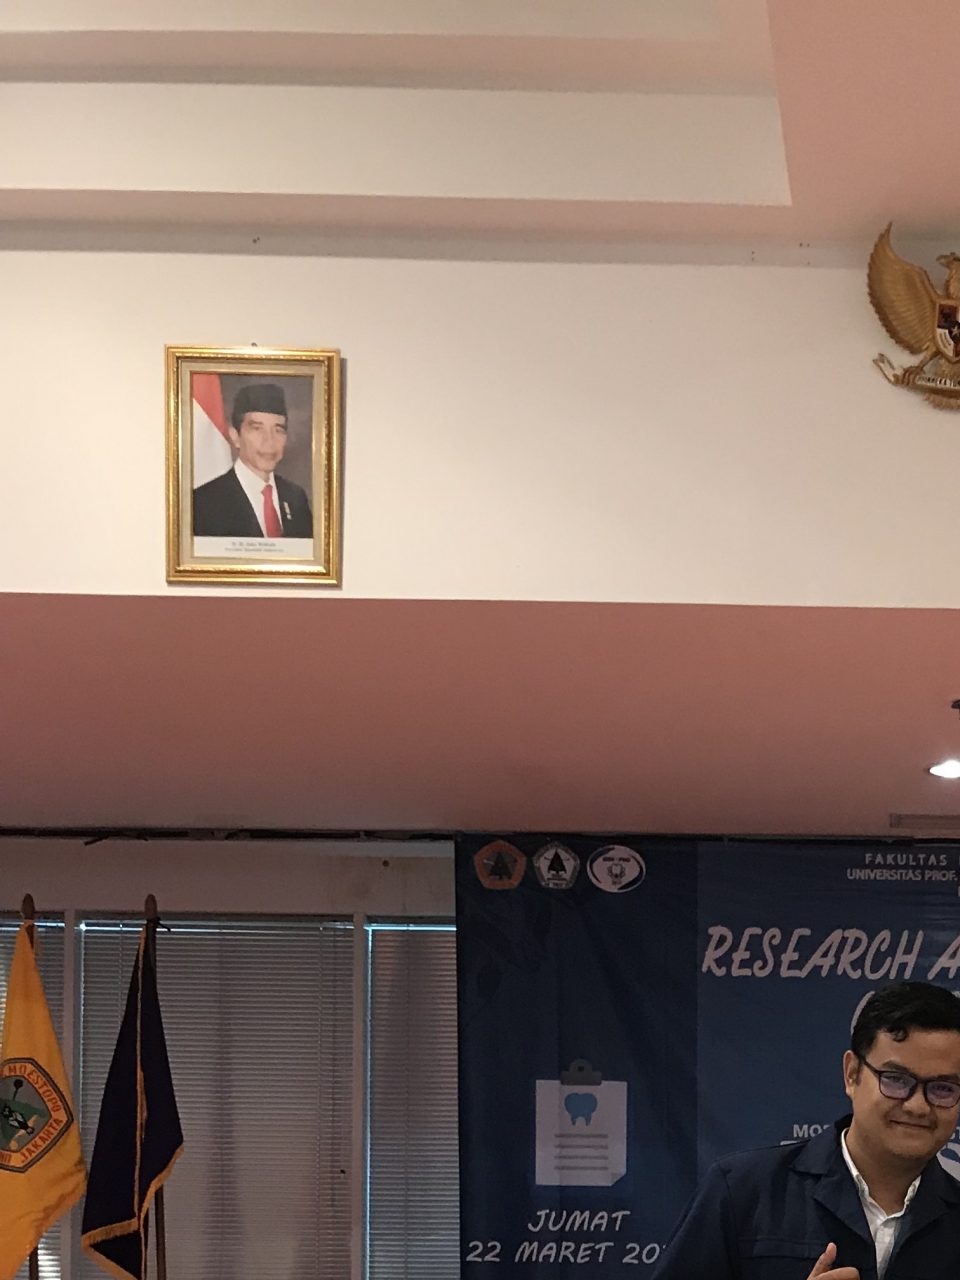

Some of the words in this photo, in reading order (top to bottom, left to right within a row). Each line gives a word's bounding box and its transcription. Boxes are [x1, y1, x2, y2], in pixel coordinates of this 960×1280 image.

[865, 853, 947, 866] FAKULTAS
[847, 868, 921, 880] UNIVERSITAS
[925, 871, 957, 881] PROF.
[702, 925, 924, 980] RESEARCH
[8, 1065, 62, 1113] MOESTOPO
[21, 1117, 64, 1163] JAKARTA
[527, 1209, 631, 1232] JUMAT
[466, 1241, 501, 1262] 22
[514, 1241, 614, 1264] MARET
